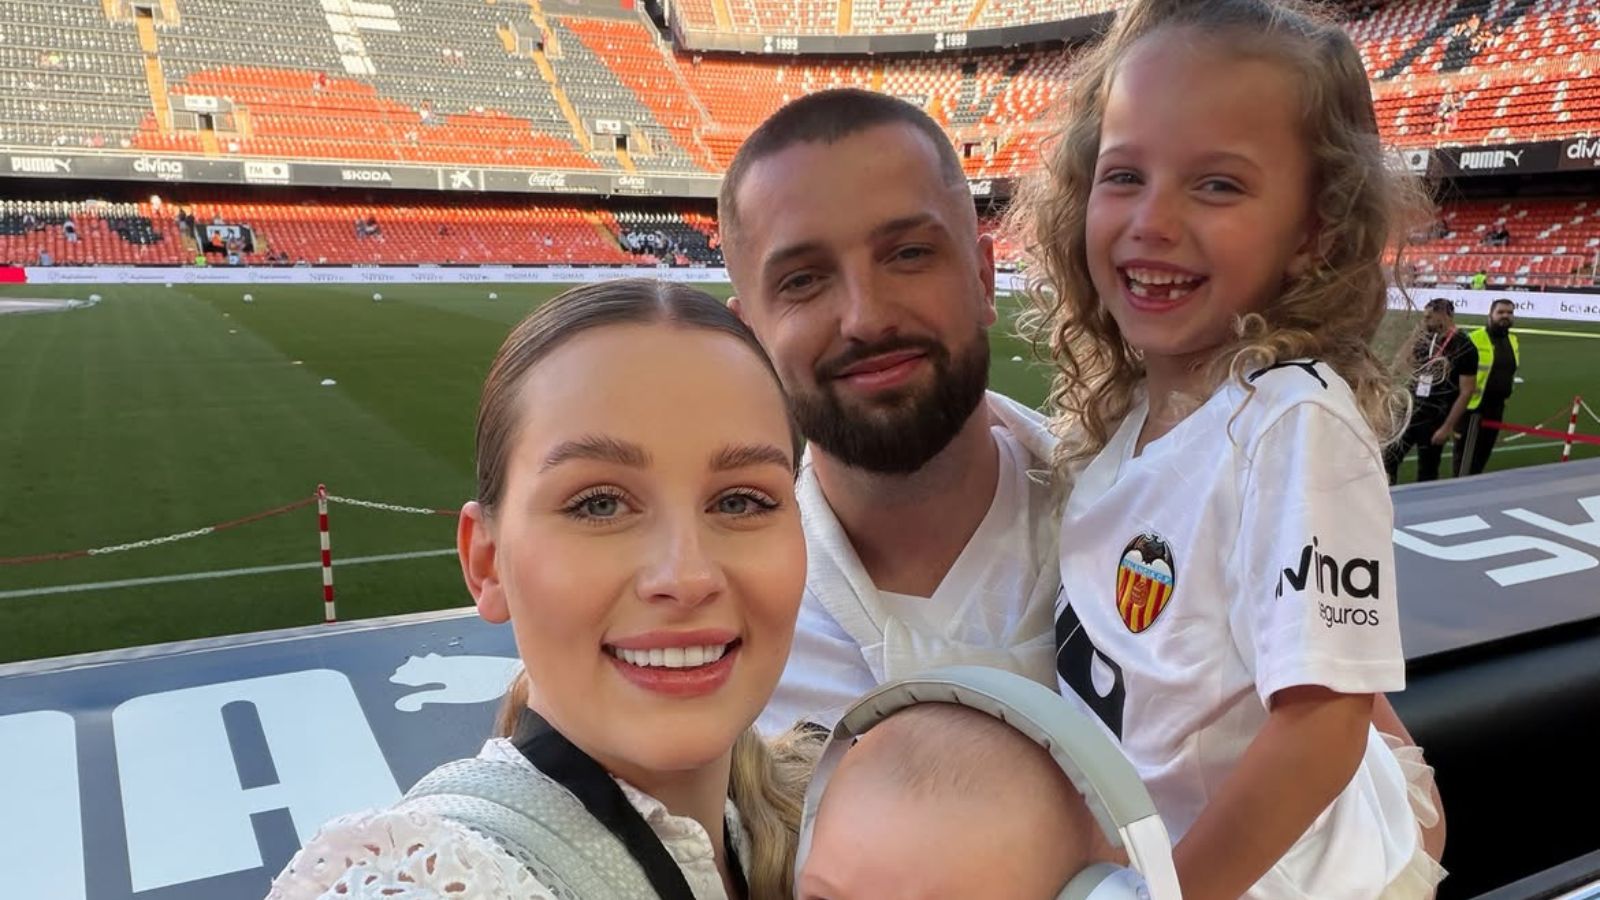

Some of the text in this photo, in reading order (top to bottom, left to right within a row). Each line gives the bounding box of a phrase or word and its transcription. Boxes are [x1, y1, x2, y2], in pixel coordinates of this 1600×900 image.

[11, 157, 57, 172] PUMA
[133, 157, 183, 174] divina
[1459, 150, 1505, 169] PUMA
